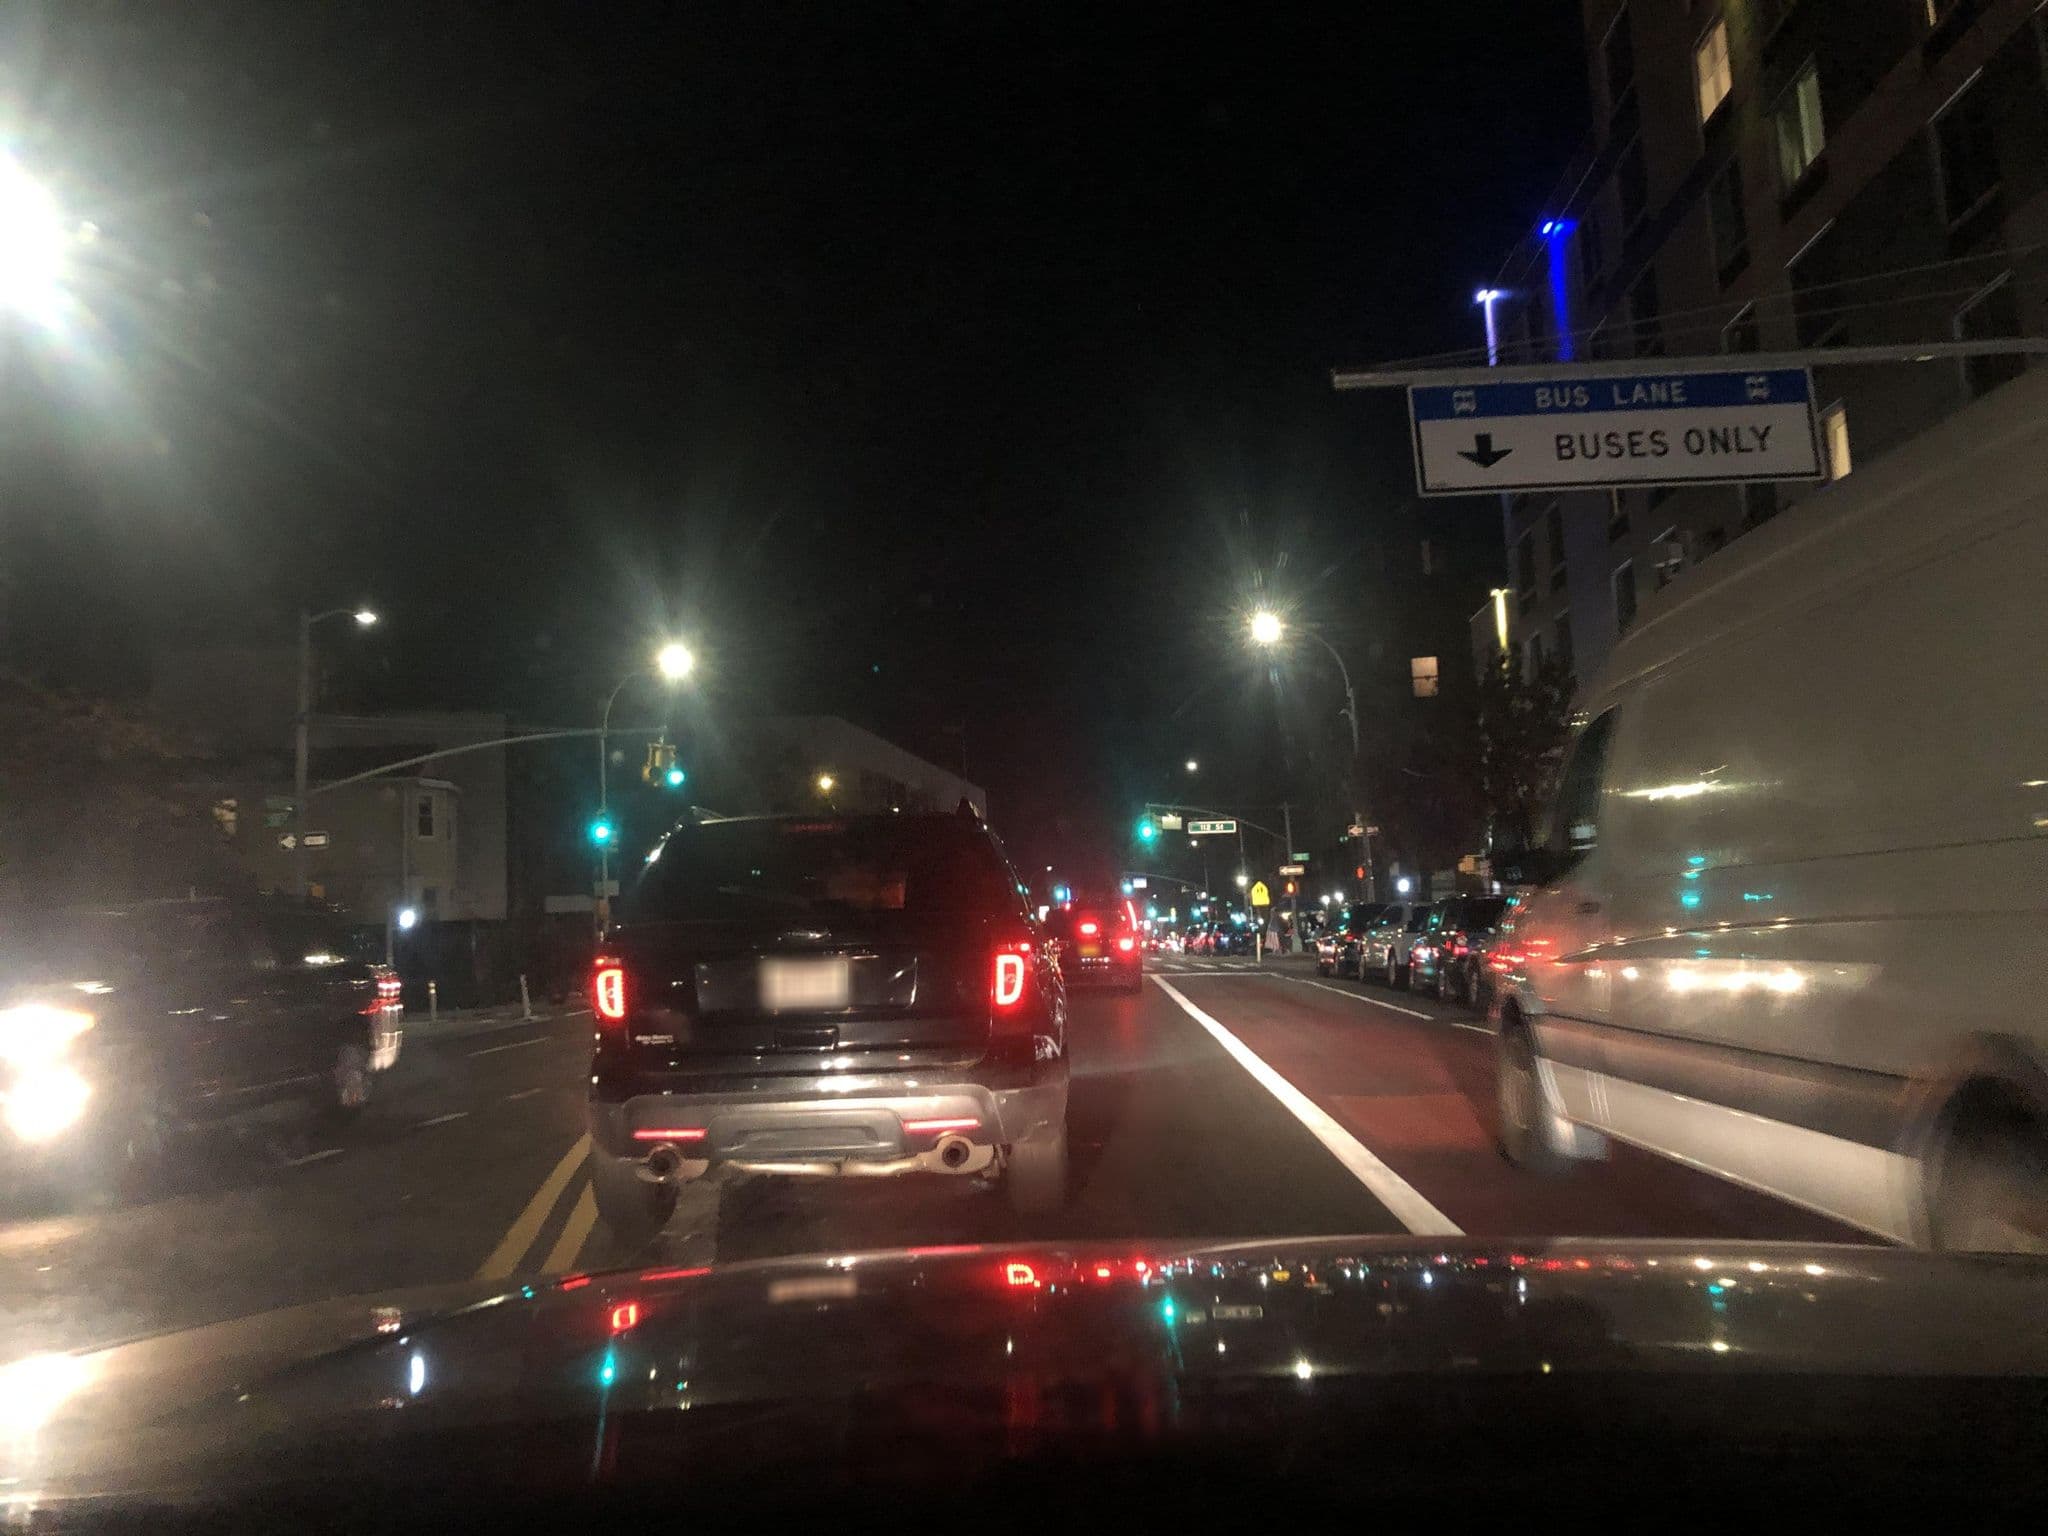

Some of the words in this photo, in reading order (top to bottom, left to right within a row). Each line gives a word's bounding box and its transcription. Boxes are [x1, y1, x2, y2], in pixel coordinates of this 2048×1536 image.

[1534, 386, 1590, 408] BUS
[1612, 381, 1688, 405] LANE
[1554, 429, 1670, 461] BUSES
[1683, 424, 1773, 456] ONLY
